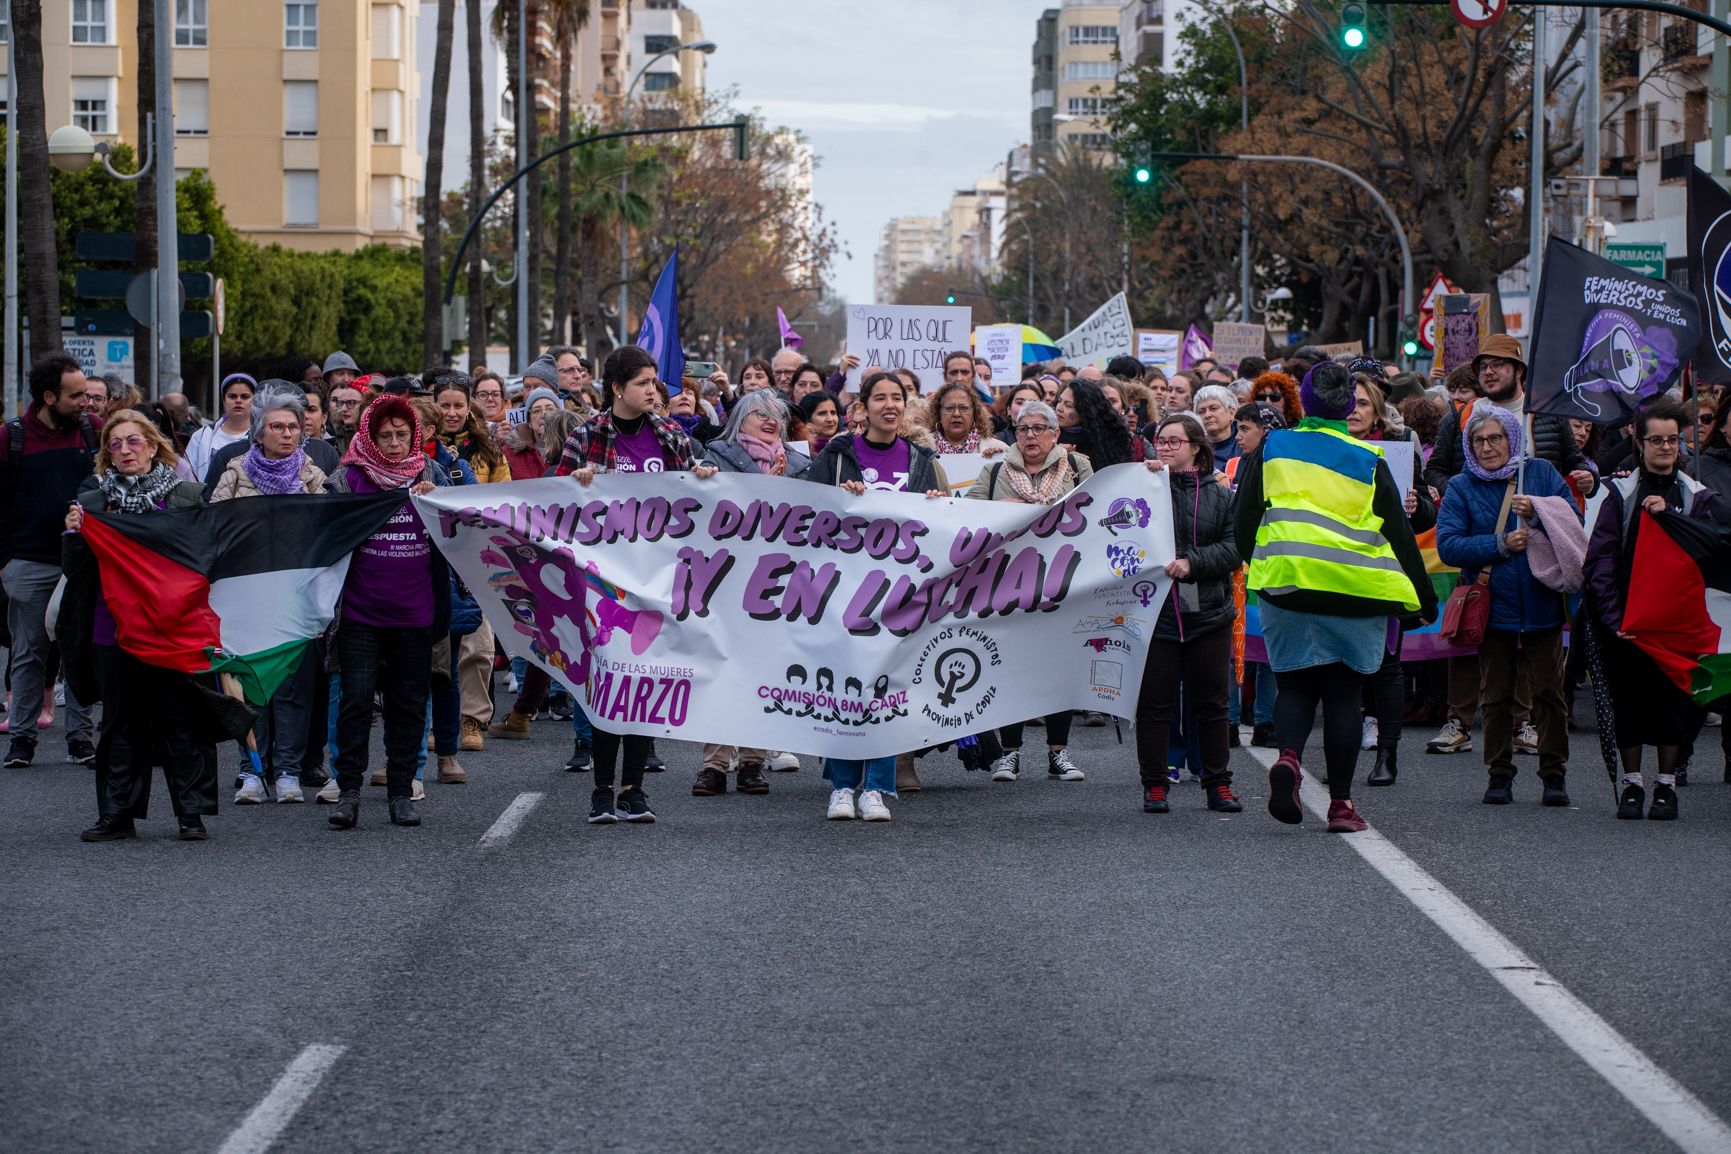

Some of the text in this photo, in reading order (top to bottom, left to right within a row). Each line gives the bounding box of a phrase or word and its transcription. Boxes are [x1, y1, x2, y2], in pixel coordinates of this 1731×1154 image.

[1606, 250, 1663, 261] FARMACIA
[1653, 310, 1665, 320] EN
[867, 317, 953, 343] POR LAS QUE
[64, 348, 95, 357] STICA
[1060, 331, 1116, 360] ALDAD
[80, 359, 96, 367] DAD
[866, 348, 881, 368] YA
[887, 348, 905, 369] NO
[509, 411, 527, 425] ALT
[617, 456, 631, 464] NA
[369, 533, 417, 541] SPUESTA
[708, 499, 933, 573] DIVERSOS,
[949, 491, 1093, 568] UOS
[743, 553, 841, 625] EN
[842, 544, 1081, 637] LUCHA!
[612, 662, 626, 673] DE
[628, 664, 647, 674] LAS
[649, 665, 694, 678] MUJERES
[1092, 687, 1121, 696] APDHA
[591, 671, 691, 727] MARZO
[757, 686, 909, 713] COMISIÓN 8M CÁDIZ
[964, 711, 974, 725] DE
